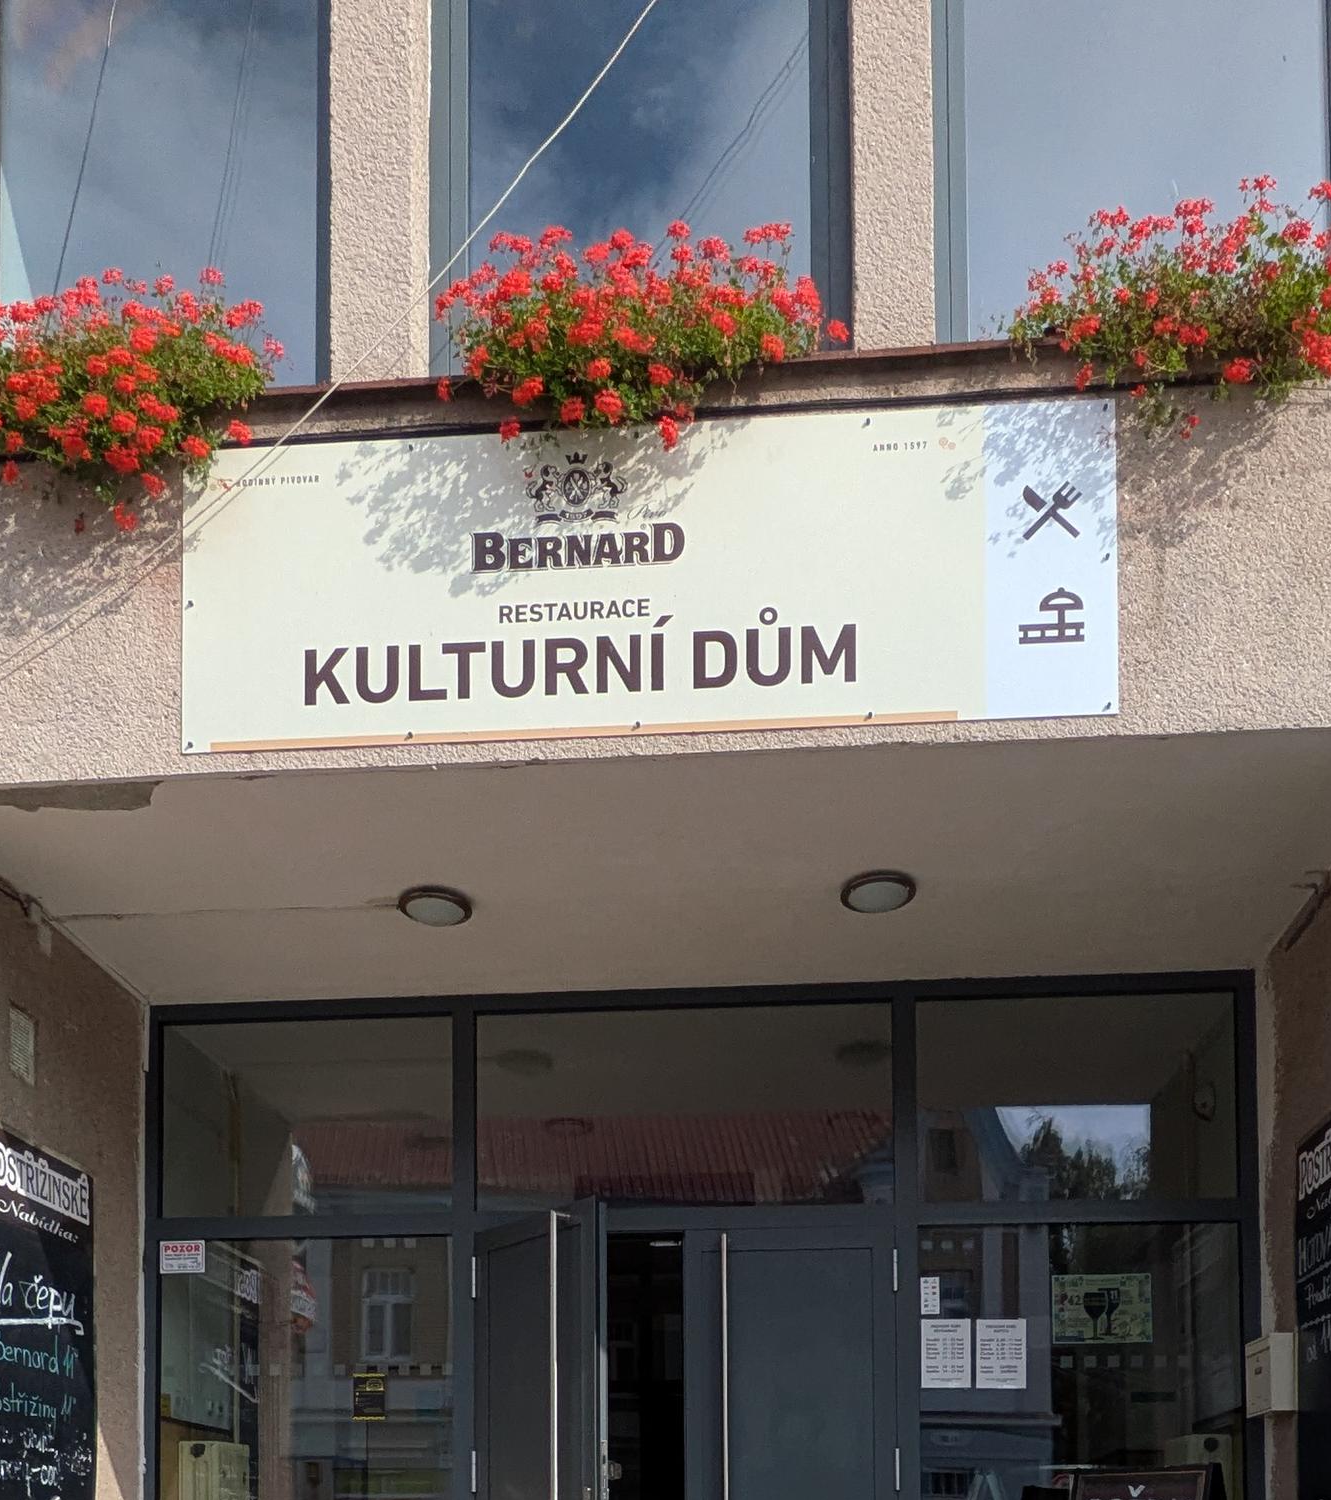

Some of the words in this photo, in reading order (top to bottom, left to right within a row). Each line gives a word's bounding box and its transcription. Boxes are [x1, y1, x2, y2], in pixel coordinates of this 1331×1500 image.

[872, 442, 899, 452] ANNO
[904, 440, 927, 451] 1597
[280, 474, 320, 485] PIVOVAR
[470, 521, 686, 574] BERNARD
[498, 598, 651, 625] RESTAURACE
[303, 614, 675, 707] KULTURNÍ
[692, 606, 858, 690] DŮM
[25, 1274, 76, 1329] čepu
